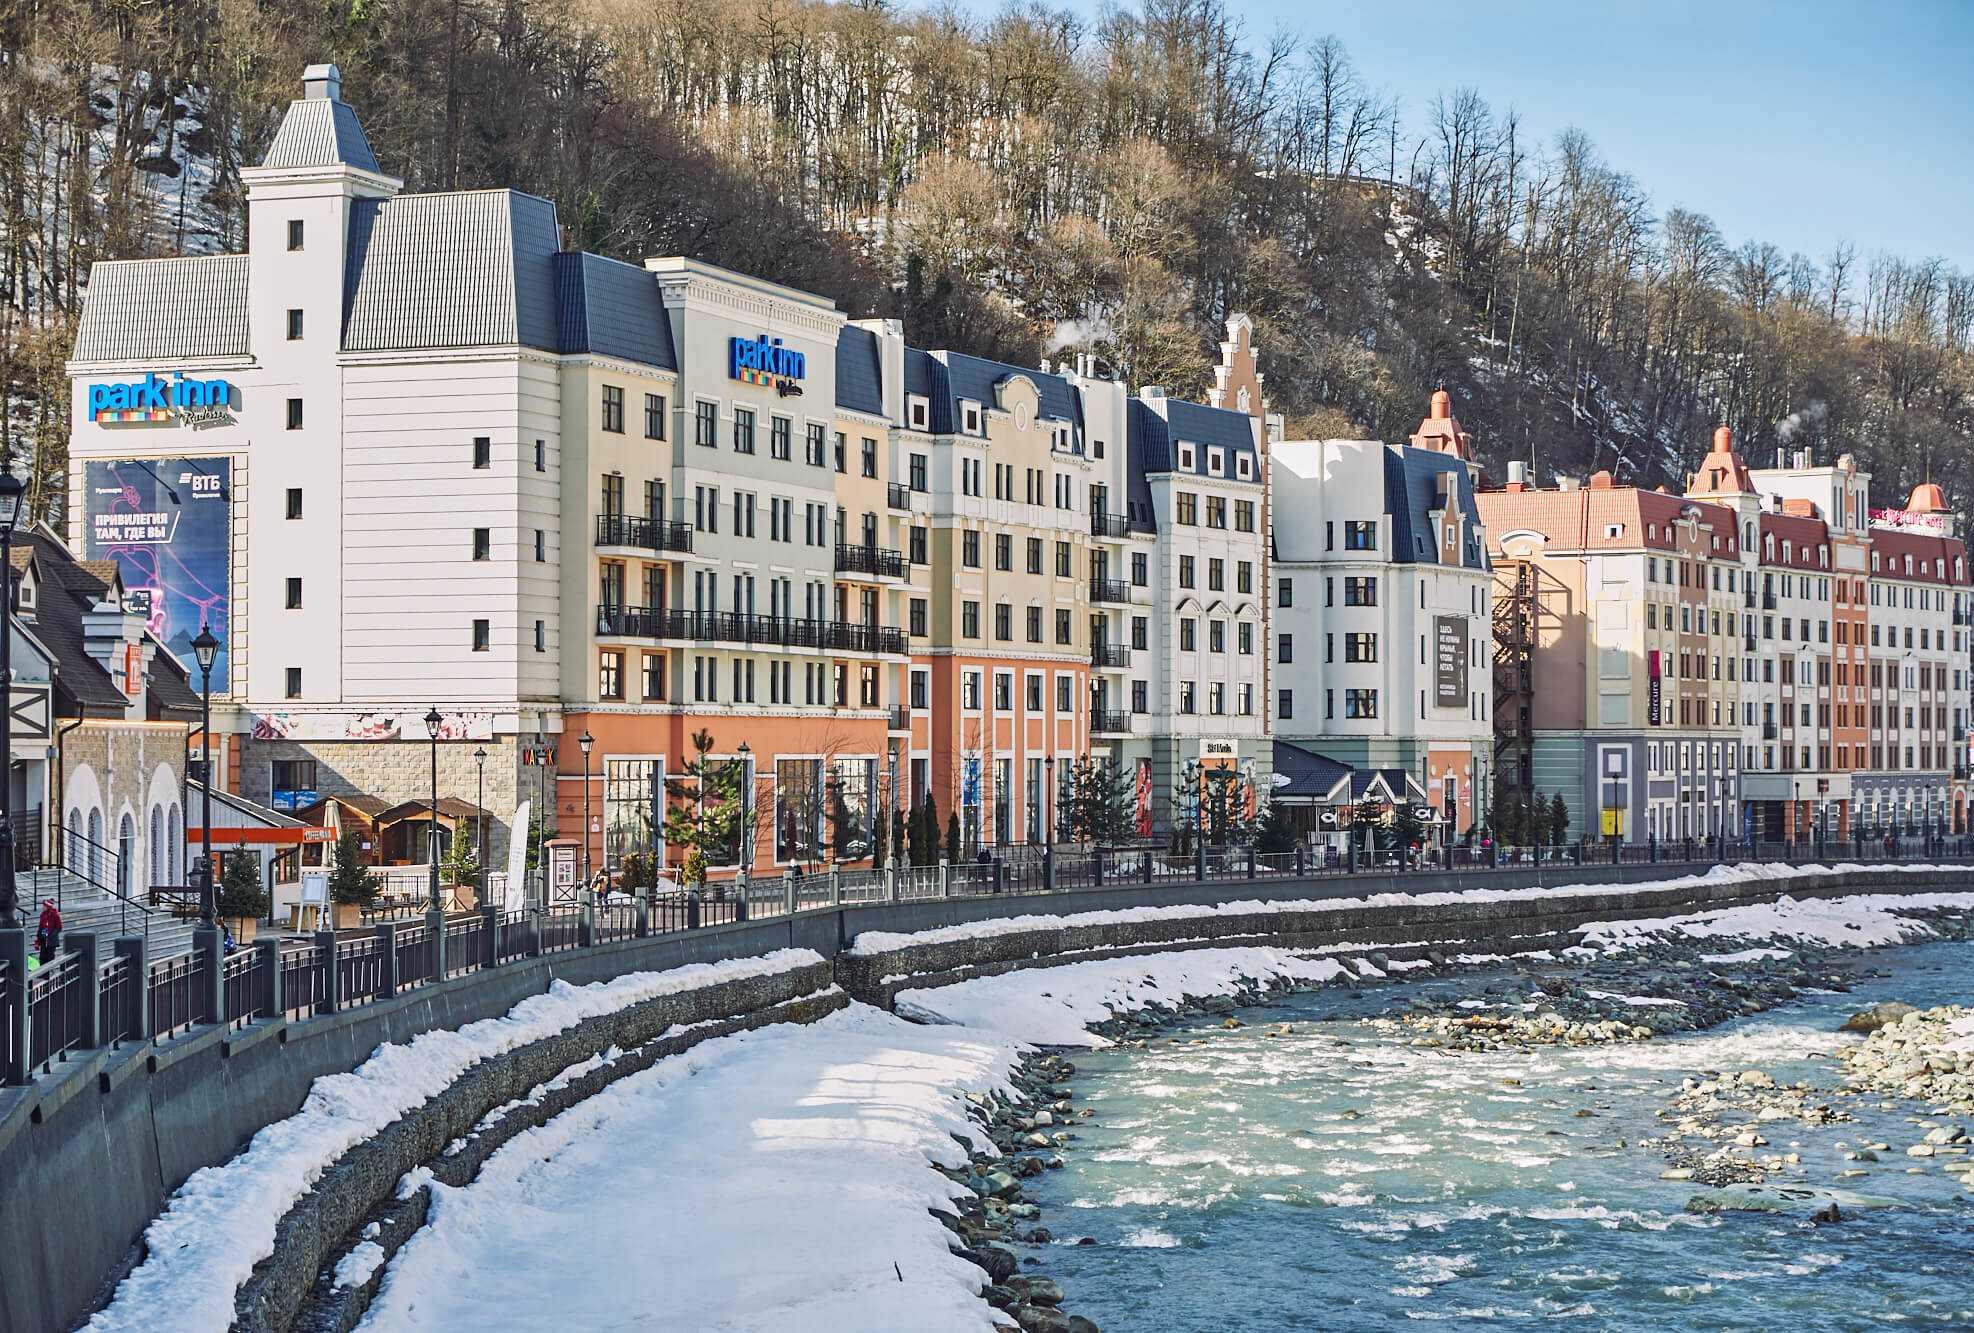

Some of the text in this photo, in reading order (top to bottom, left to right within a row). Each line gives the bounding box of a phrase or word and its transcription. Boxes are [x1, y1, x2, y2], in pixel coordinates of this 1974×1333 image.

[727, 334, 806, 380] park inn
[88, 371, 229, 422] park inn
[192, 475, 220, 491] ВТБ
[95, 513, 169, 526] ПРИВИЛЕГИЯ
[95, 526, 166, 540] ТАМ, ГДЕ ВЫ
